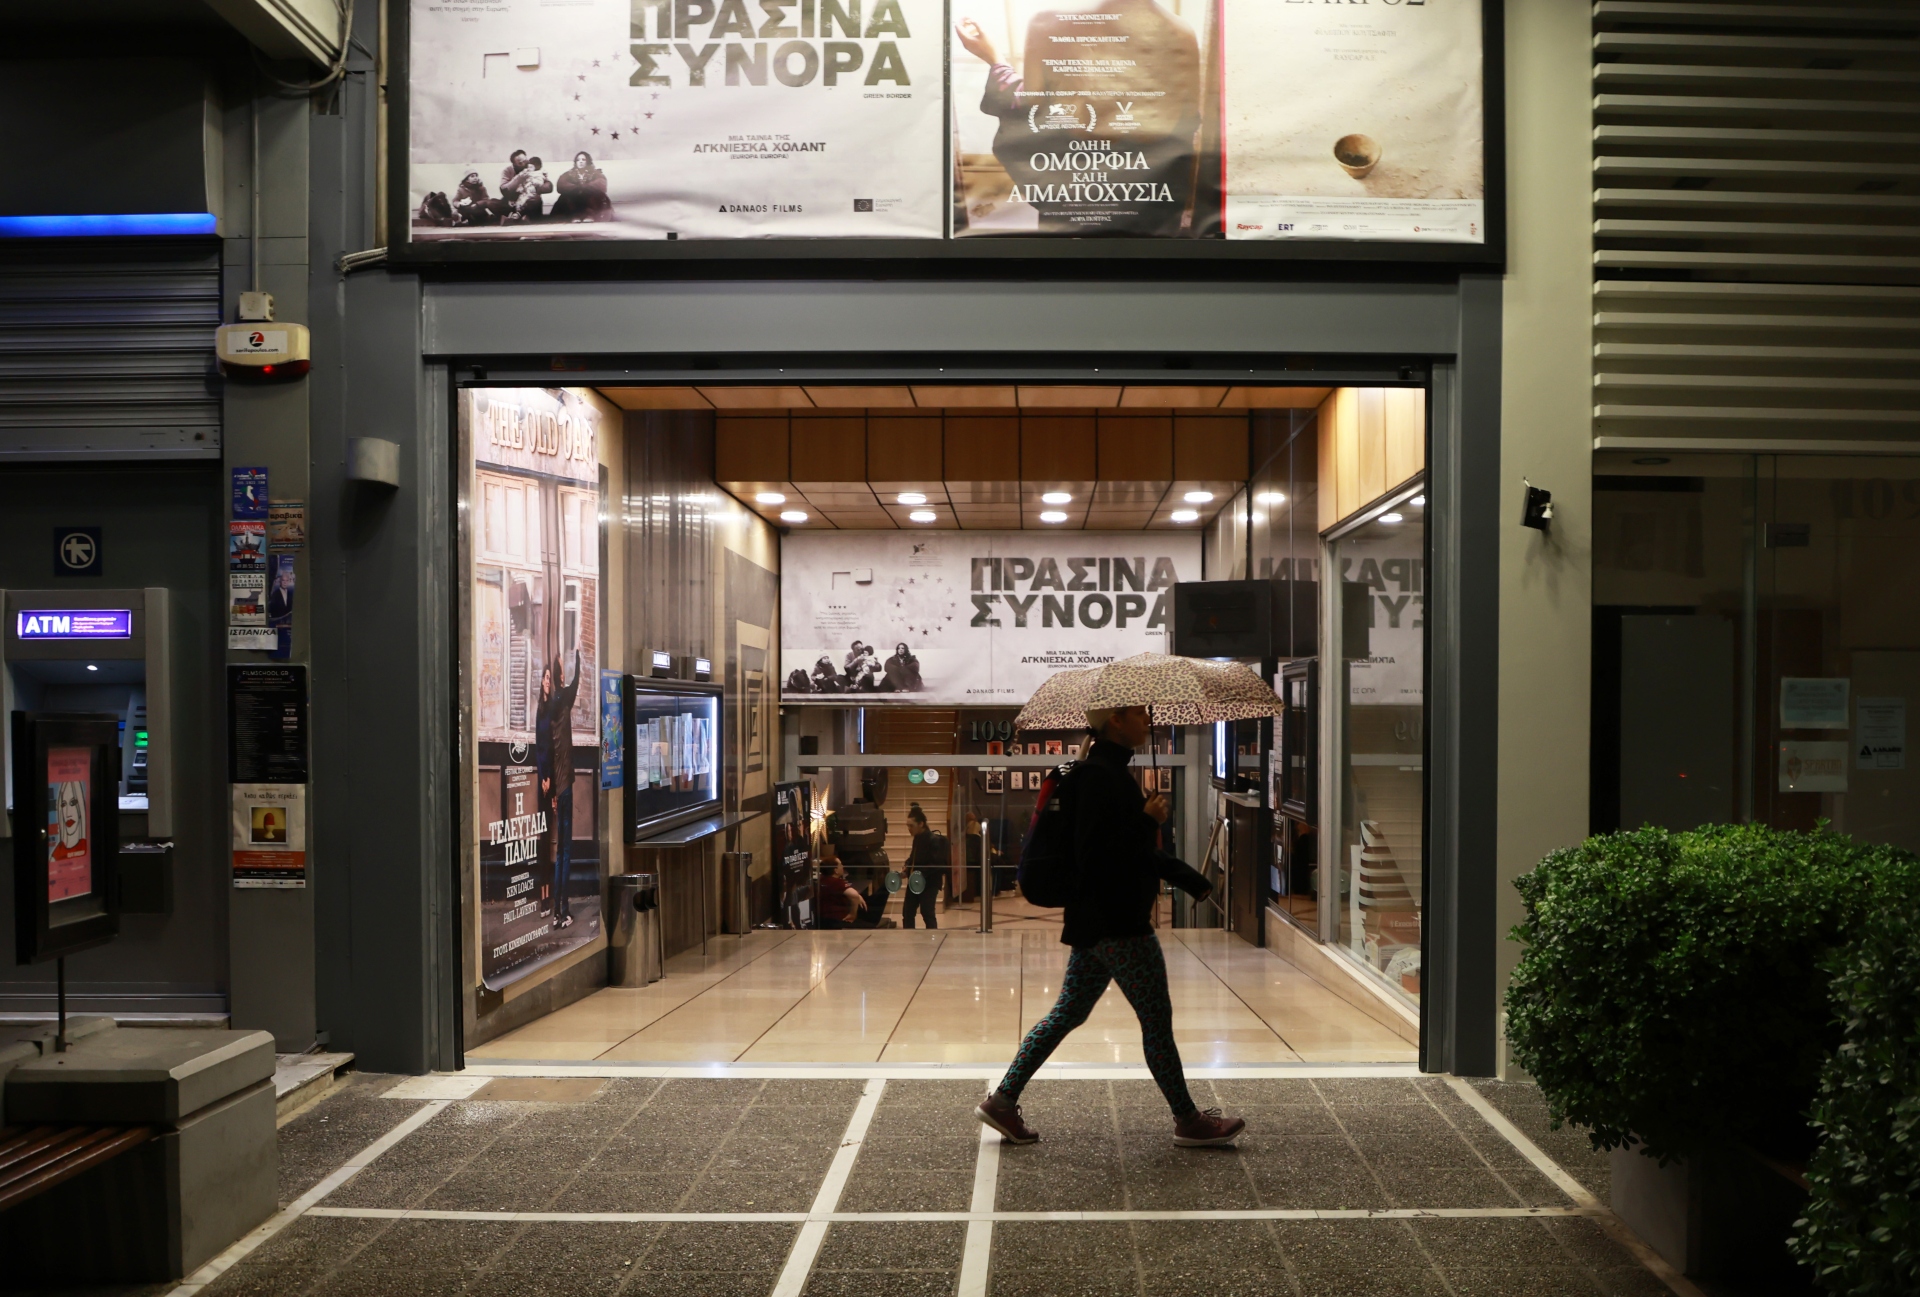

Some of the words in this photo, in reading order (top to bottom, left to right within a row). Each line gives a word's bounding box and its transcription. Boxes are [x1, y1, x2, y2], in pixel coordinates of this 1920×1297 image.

[629, 0, 910, 38] ΠΡΑΣΙΝΑ
[629, 42, 910, 87] ΣΥΝΟΡΑ
[693, 143, 768, 153] ΑΓΚΝΙΕΣΚΑ
[772, 142, 826, 152] ΧΟΛΑΝΤ
[1068, 140, 1098, 151] ΟΛΗ
[1100, 140, 1111, 150] Η
[1030, 151, 1150, 172] ΟΜΟΡΦΙΑ
[1072, 172, 1095, 182] ΚΑΙ
[1097, 172, 1108, 182] Η
[1006, 183, 1175, 203] ΑΙΜΑΤΟΧΥΣΙΑ
[730, 205, 768, 213] DANAOS
[1278, 223, 1294, 231] ERT
[488, 398, 523, 450] THE
[527, 406, 559, 456] OLD
[971, 557, 1180, 592] ΠΡΑΣΙΝΑ
[25, 616, 70, 633] ATM
[970, 720, 1012, 742] 109
[515, 792, 524, 816] Η
[489, 811, 548, 846] ΤΕΛΕΥΤΑΙΑ
[505, 836, 537, 866] ΠΑΜΠ
[506, 884, 518, 898] KEN
[517, 878, 534, 894] LOACH
[503, 909, 516, 925] PAUL
[516, 900, 538, 919] LAVERTY
